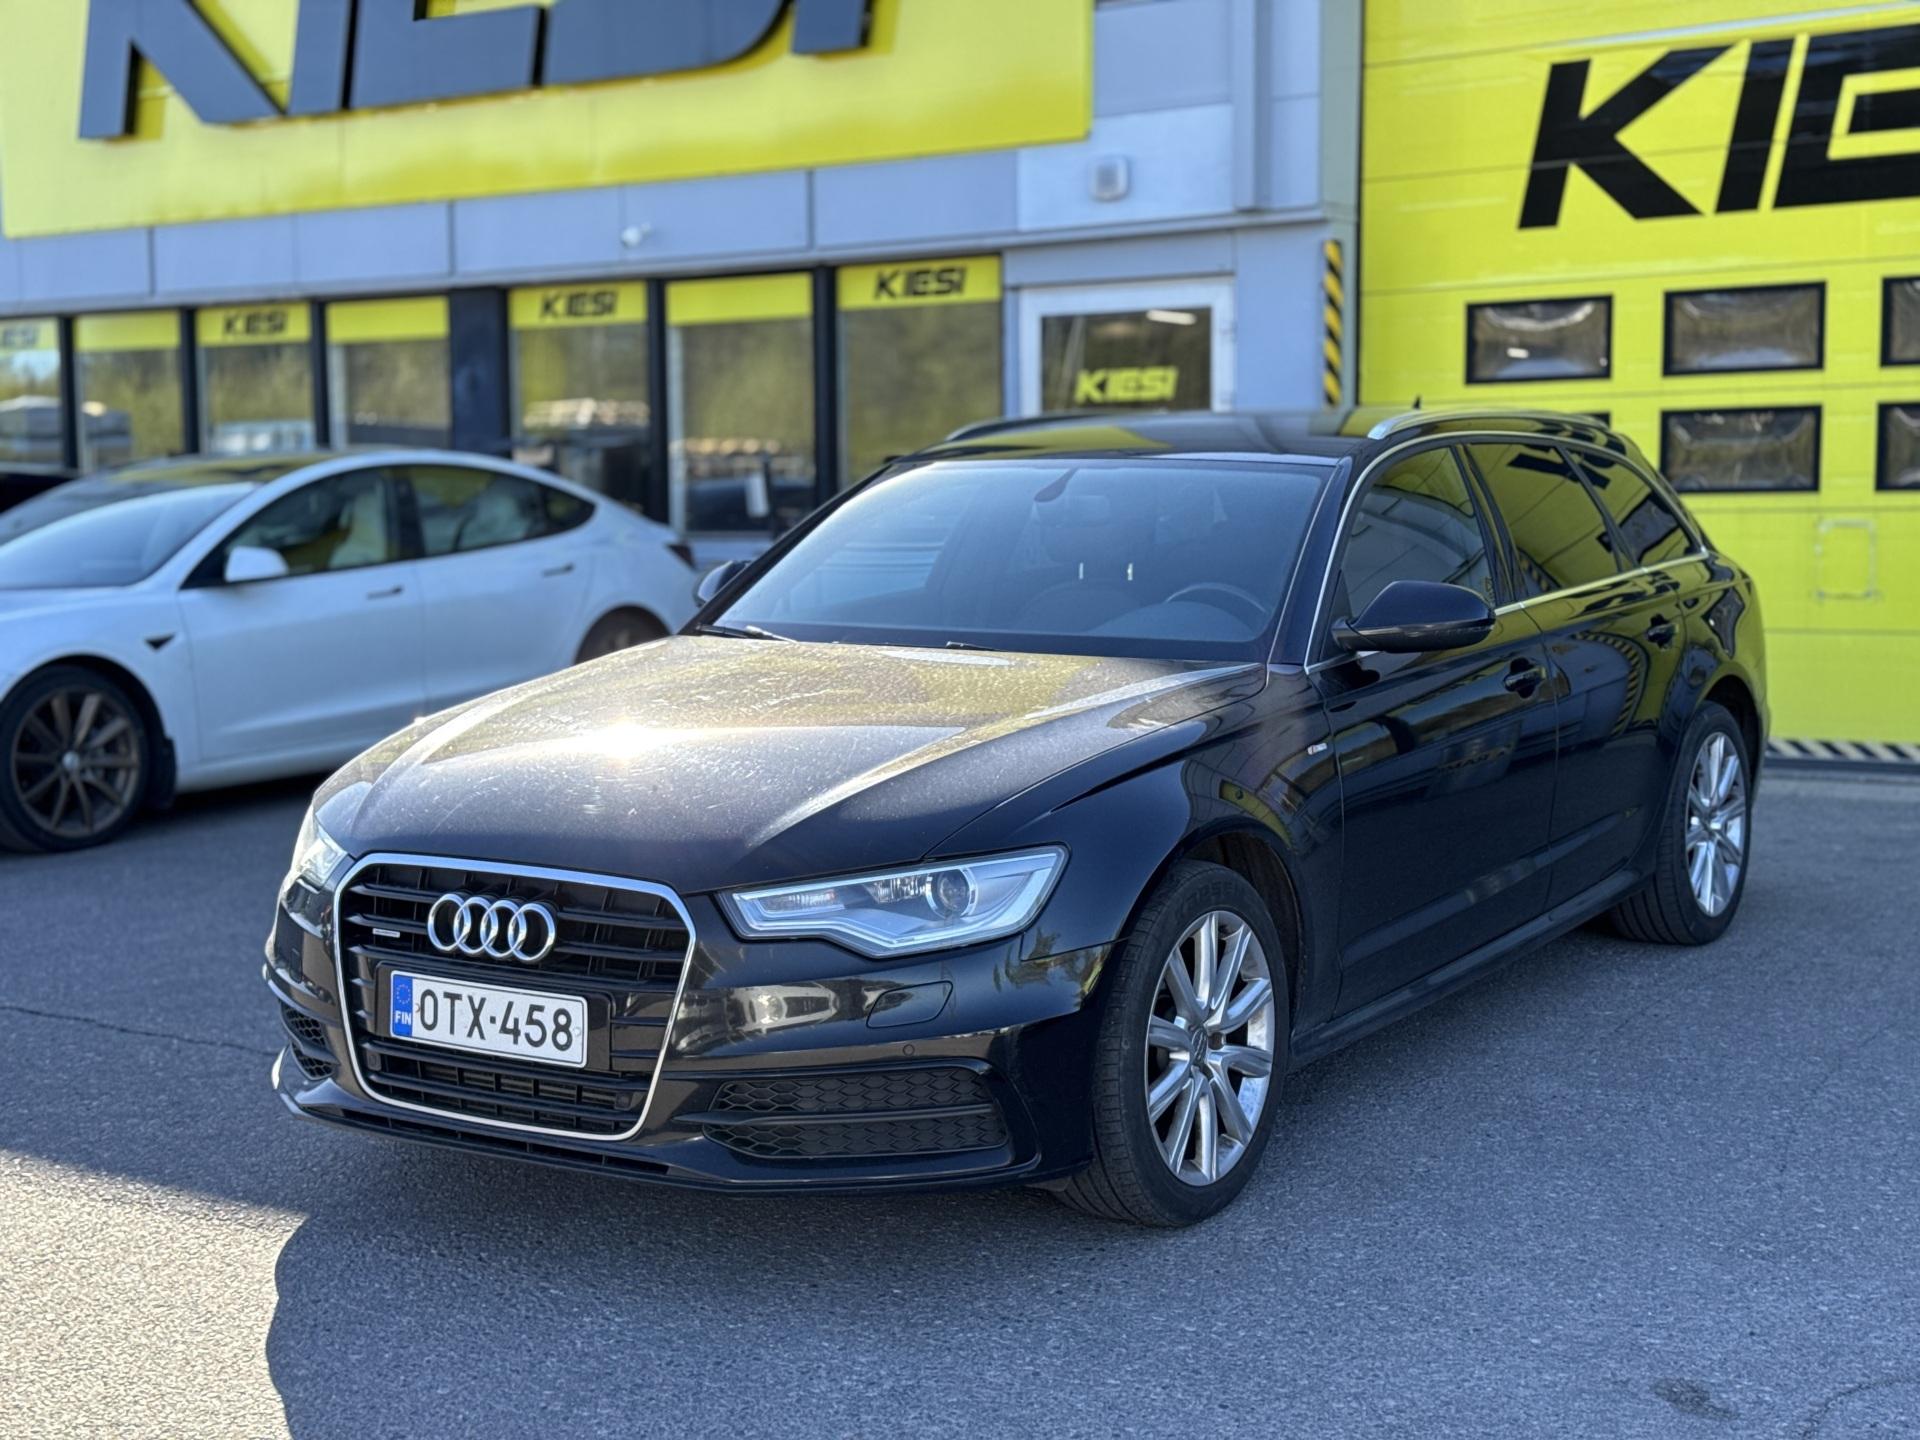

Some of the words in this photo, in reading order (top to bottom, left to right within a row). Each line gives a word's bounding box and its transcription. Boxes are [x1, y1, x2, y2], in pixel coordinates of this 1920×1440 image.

[874, 267, 966, 299] KIESI
[539, 290, 617, 318] KIESI
[223, 309, 287, 336] KIESI
[1074, 366, 1178, 404] KIESI
[395, 1009, 412, 1025] FIN
[421, 989, 572, 1051] OTX-458
